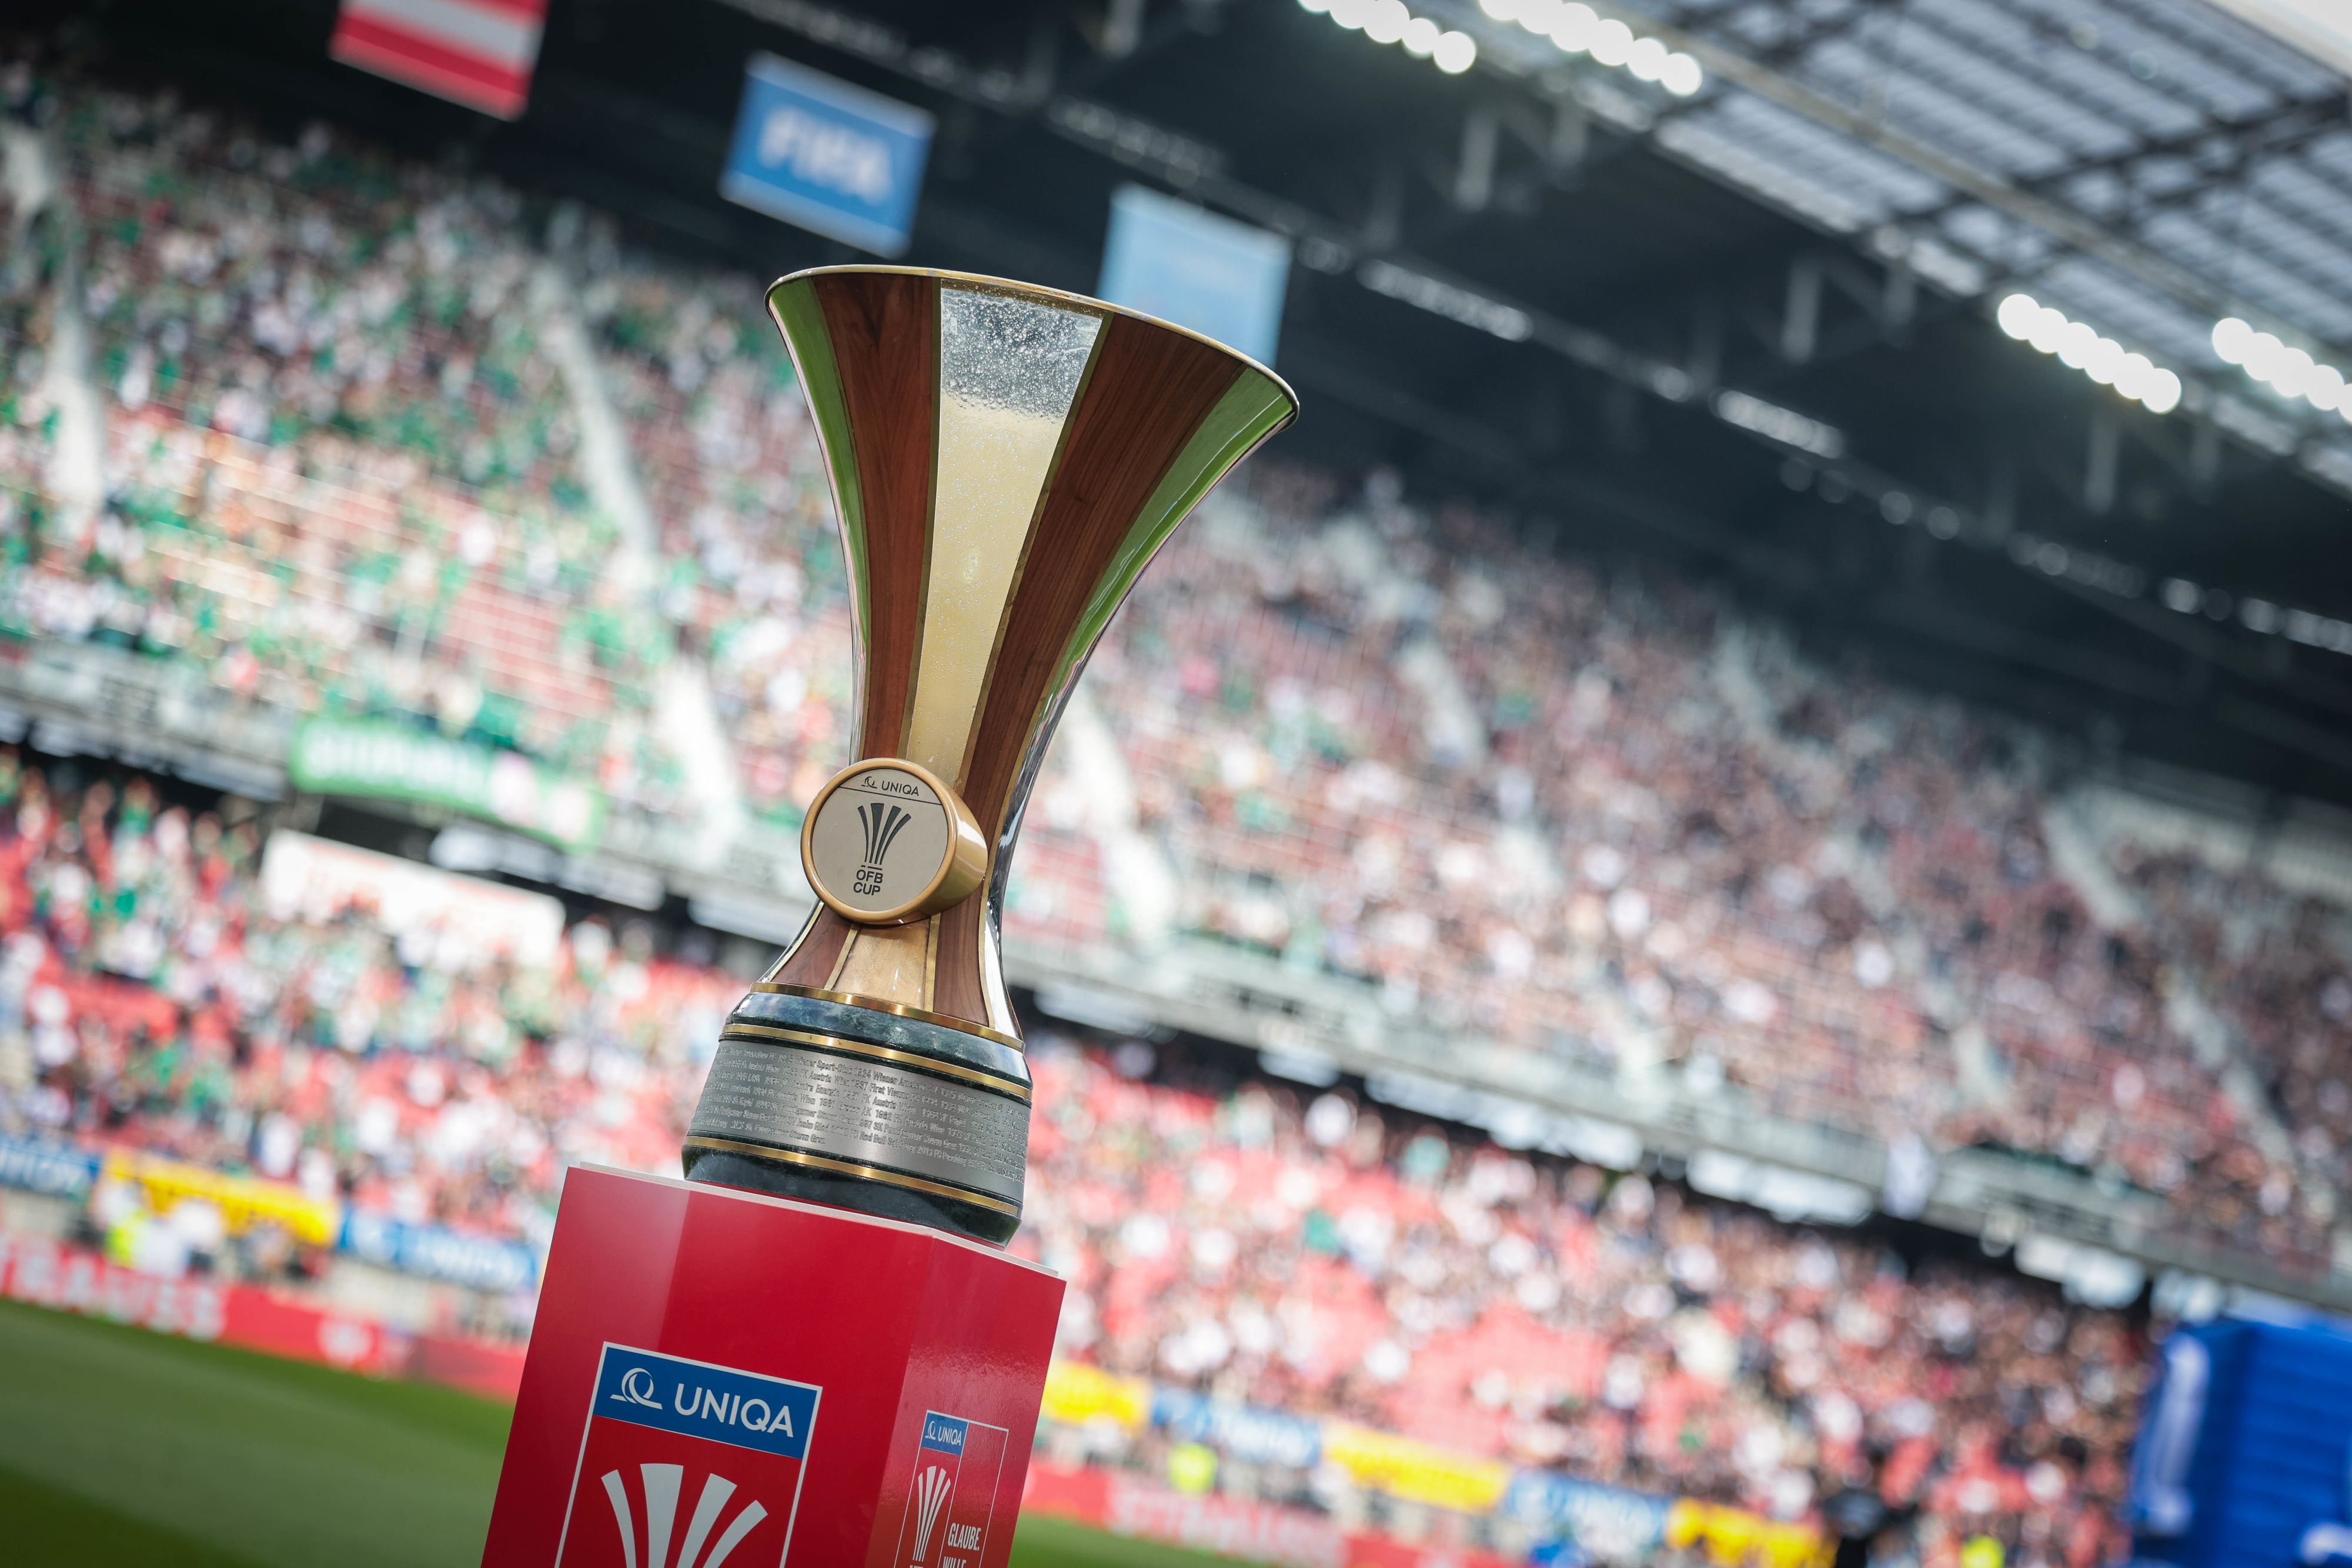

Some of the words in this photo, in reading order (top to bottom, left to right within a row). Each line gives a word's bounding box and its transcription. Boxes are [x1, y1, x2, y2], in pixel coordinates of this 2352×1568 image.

[881, 780, 919, 796] UNIQA
[853, 882, 881, 896] CUP
[808, 1070, 832, 1083] Austria
[868, 1082, 886, 1094] First
[871, 1071, 898, 1084] Wiener
[872, 1096, 897, 1109] Austria
[861, 1106, 871, 1116] AK
[873, 1121, 883, 1132] SK
[858, 1131, 873, 1142] Red
[873, 1134, 888, 1145] Bull
[674, 1383, 794, 1437] UNIQA
[938, 1426, 961, 1446] UNIQA
